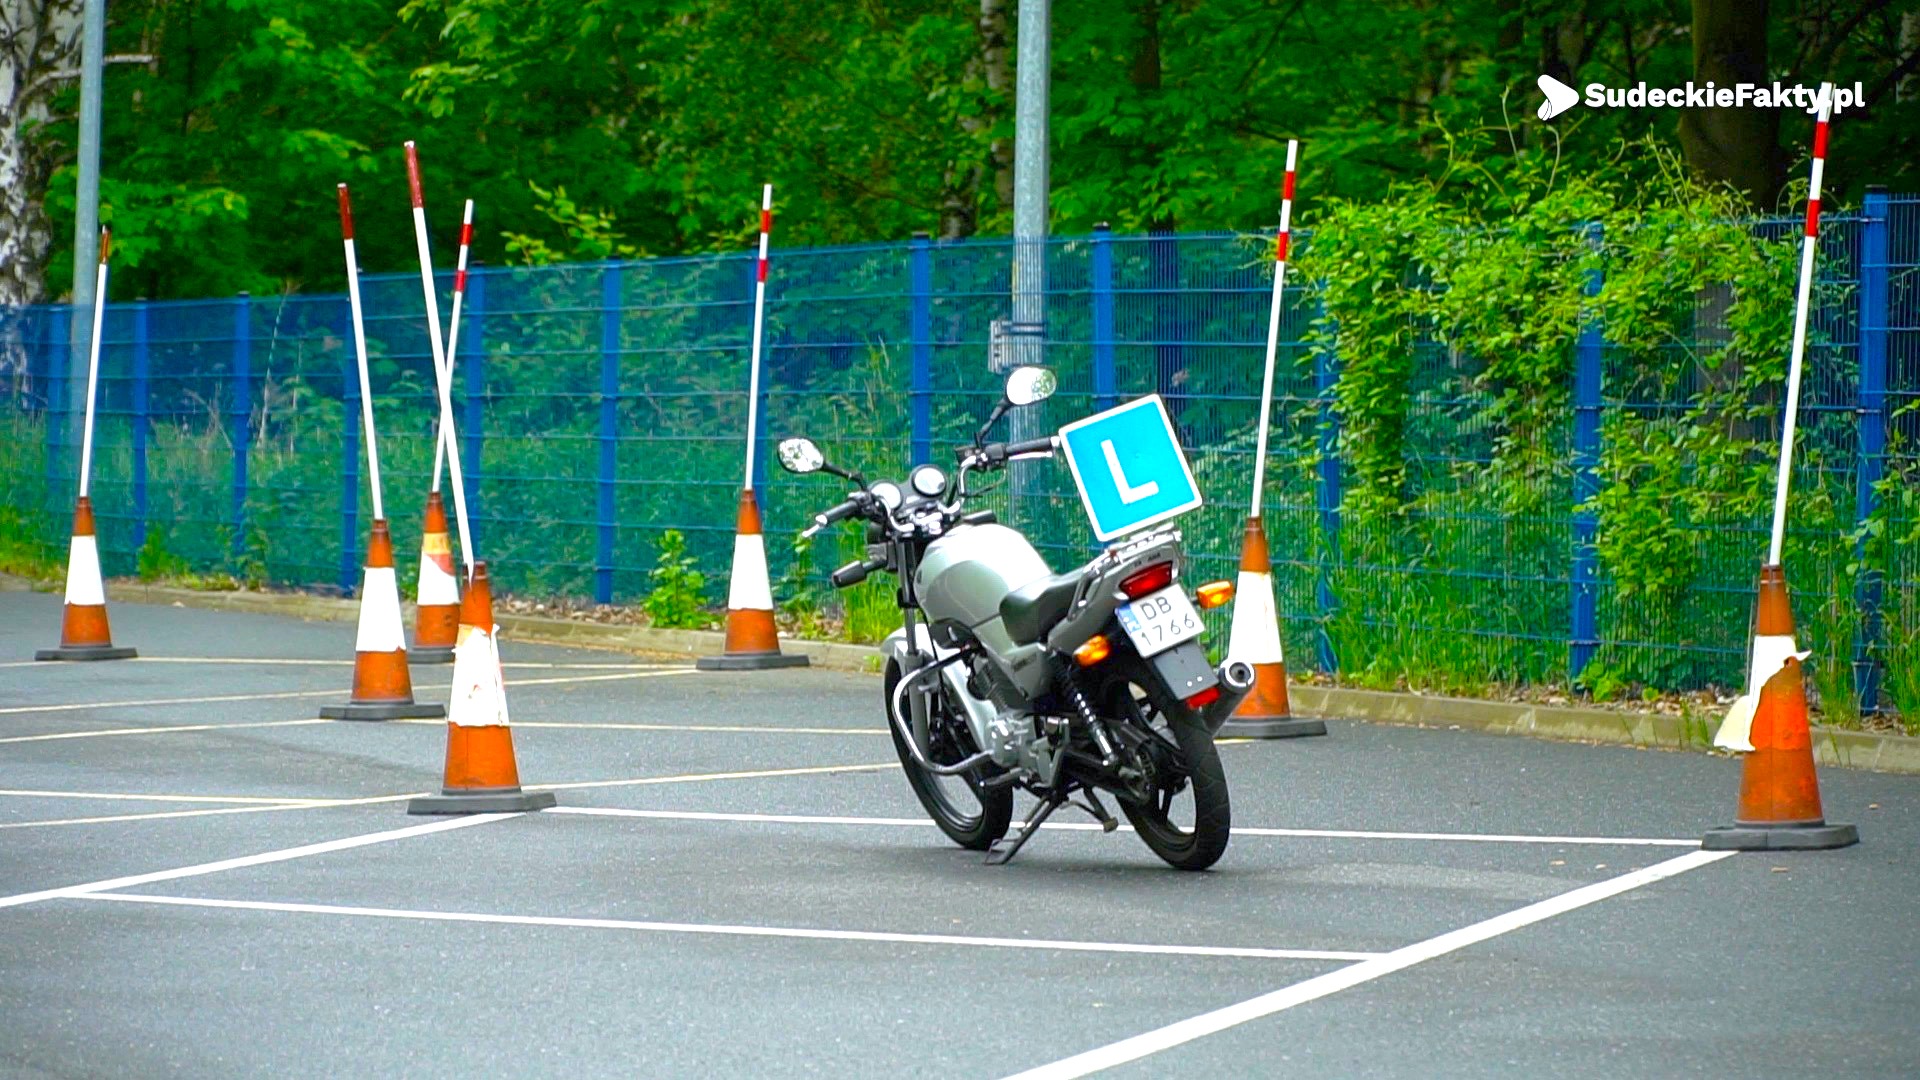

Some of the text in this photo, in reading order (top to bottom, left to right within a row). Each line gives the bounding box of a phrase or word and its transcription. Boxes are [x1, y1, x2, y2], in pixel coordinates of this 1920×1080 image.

[1100, 439, 1159, 505] L
[1140, 596, 1172, 620] DB
[1141, 613, 1195, 646] 1766
